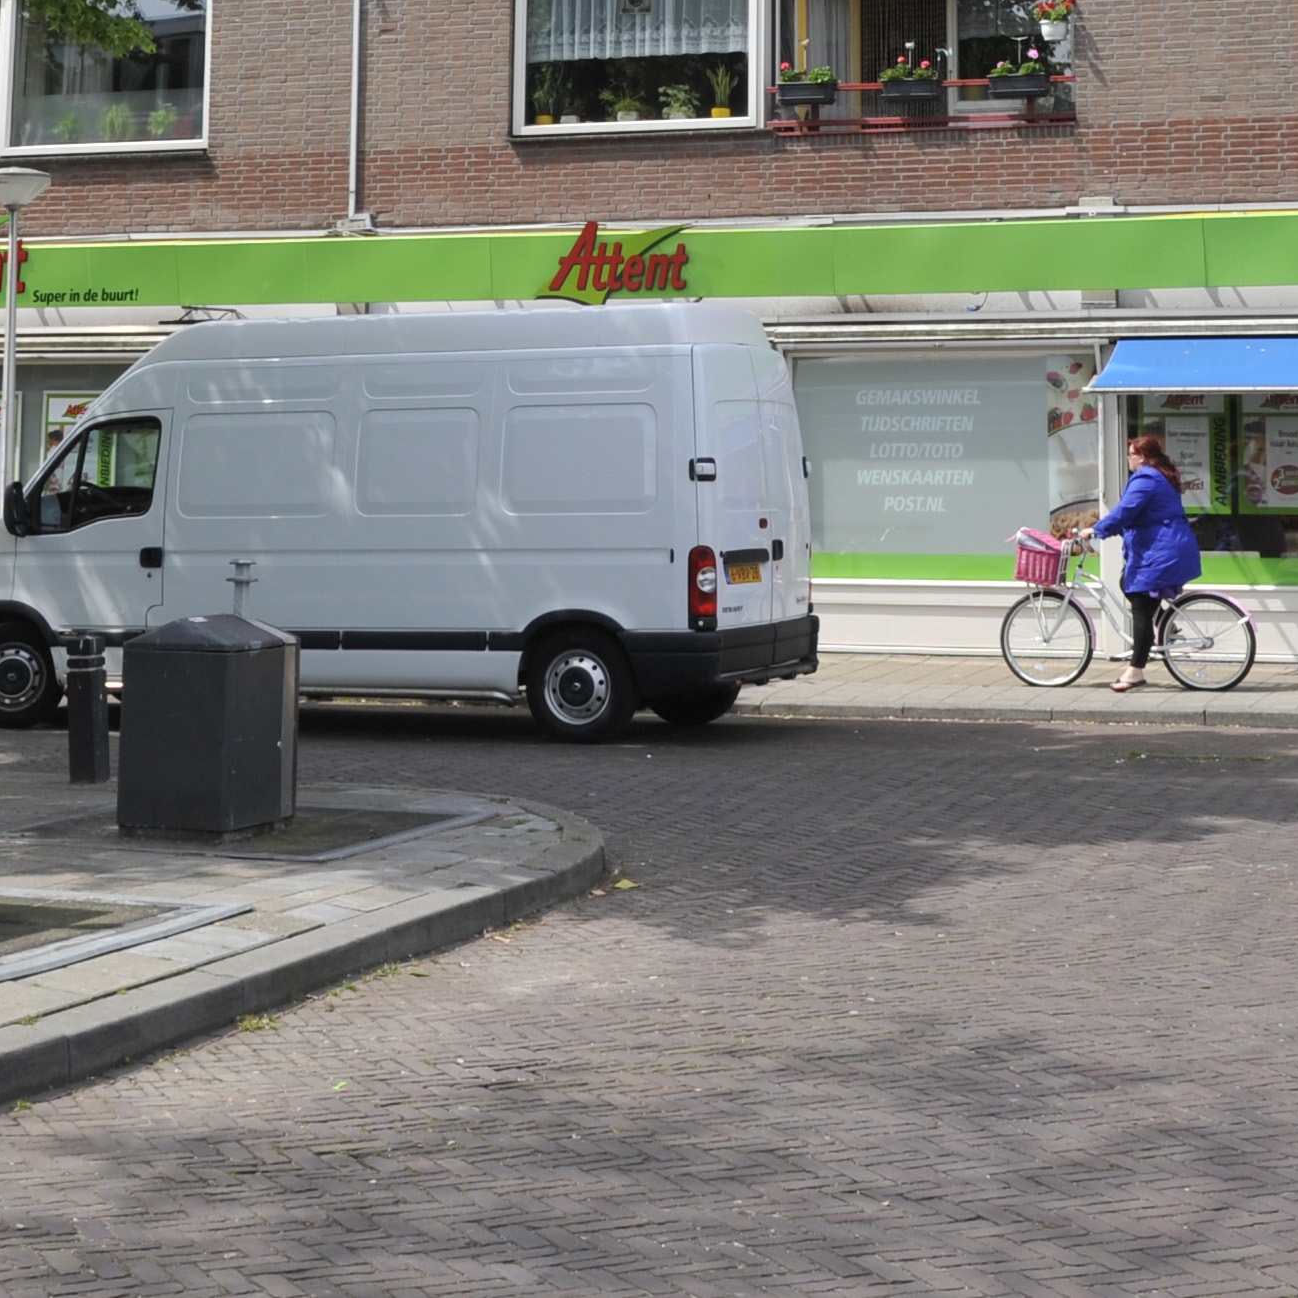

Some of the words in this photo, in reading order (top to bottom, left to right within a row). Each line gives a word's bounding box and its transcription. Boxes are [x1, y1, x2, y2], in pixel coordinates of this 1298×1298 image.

[548, 220, 689, 292] Attent
[32, 289, 67, 306] Super
[69, 289, 82, 302] in
[83, 289, 99, 302] de
[101, 288, 139, 302] buurt!
[856, 389, 981, 405] GEMAKSWINKEL
[861, 416, 974, 432] TIJDSCHRIFTEN
[869, 443, 964, 459] LOTTO/TOTO
[1214, 417, 1228, 507] AANBIEDING
[856, 470, 974, 486] WENSKAARTEN
[884, 496, 946, 512] POST.NL
